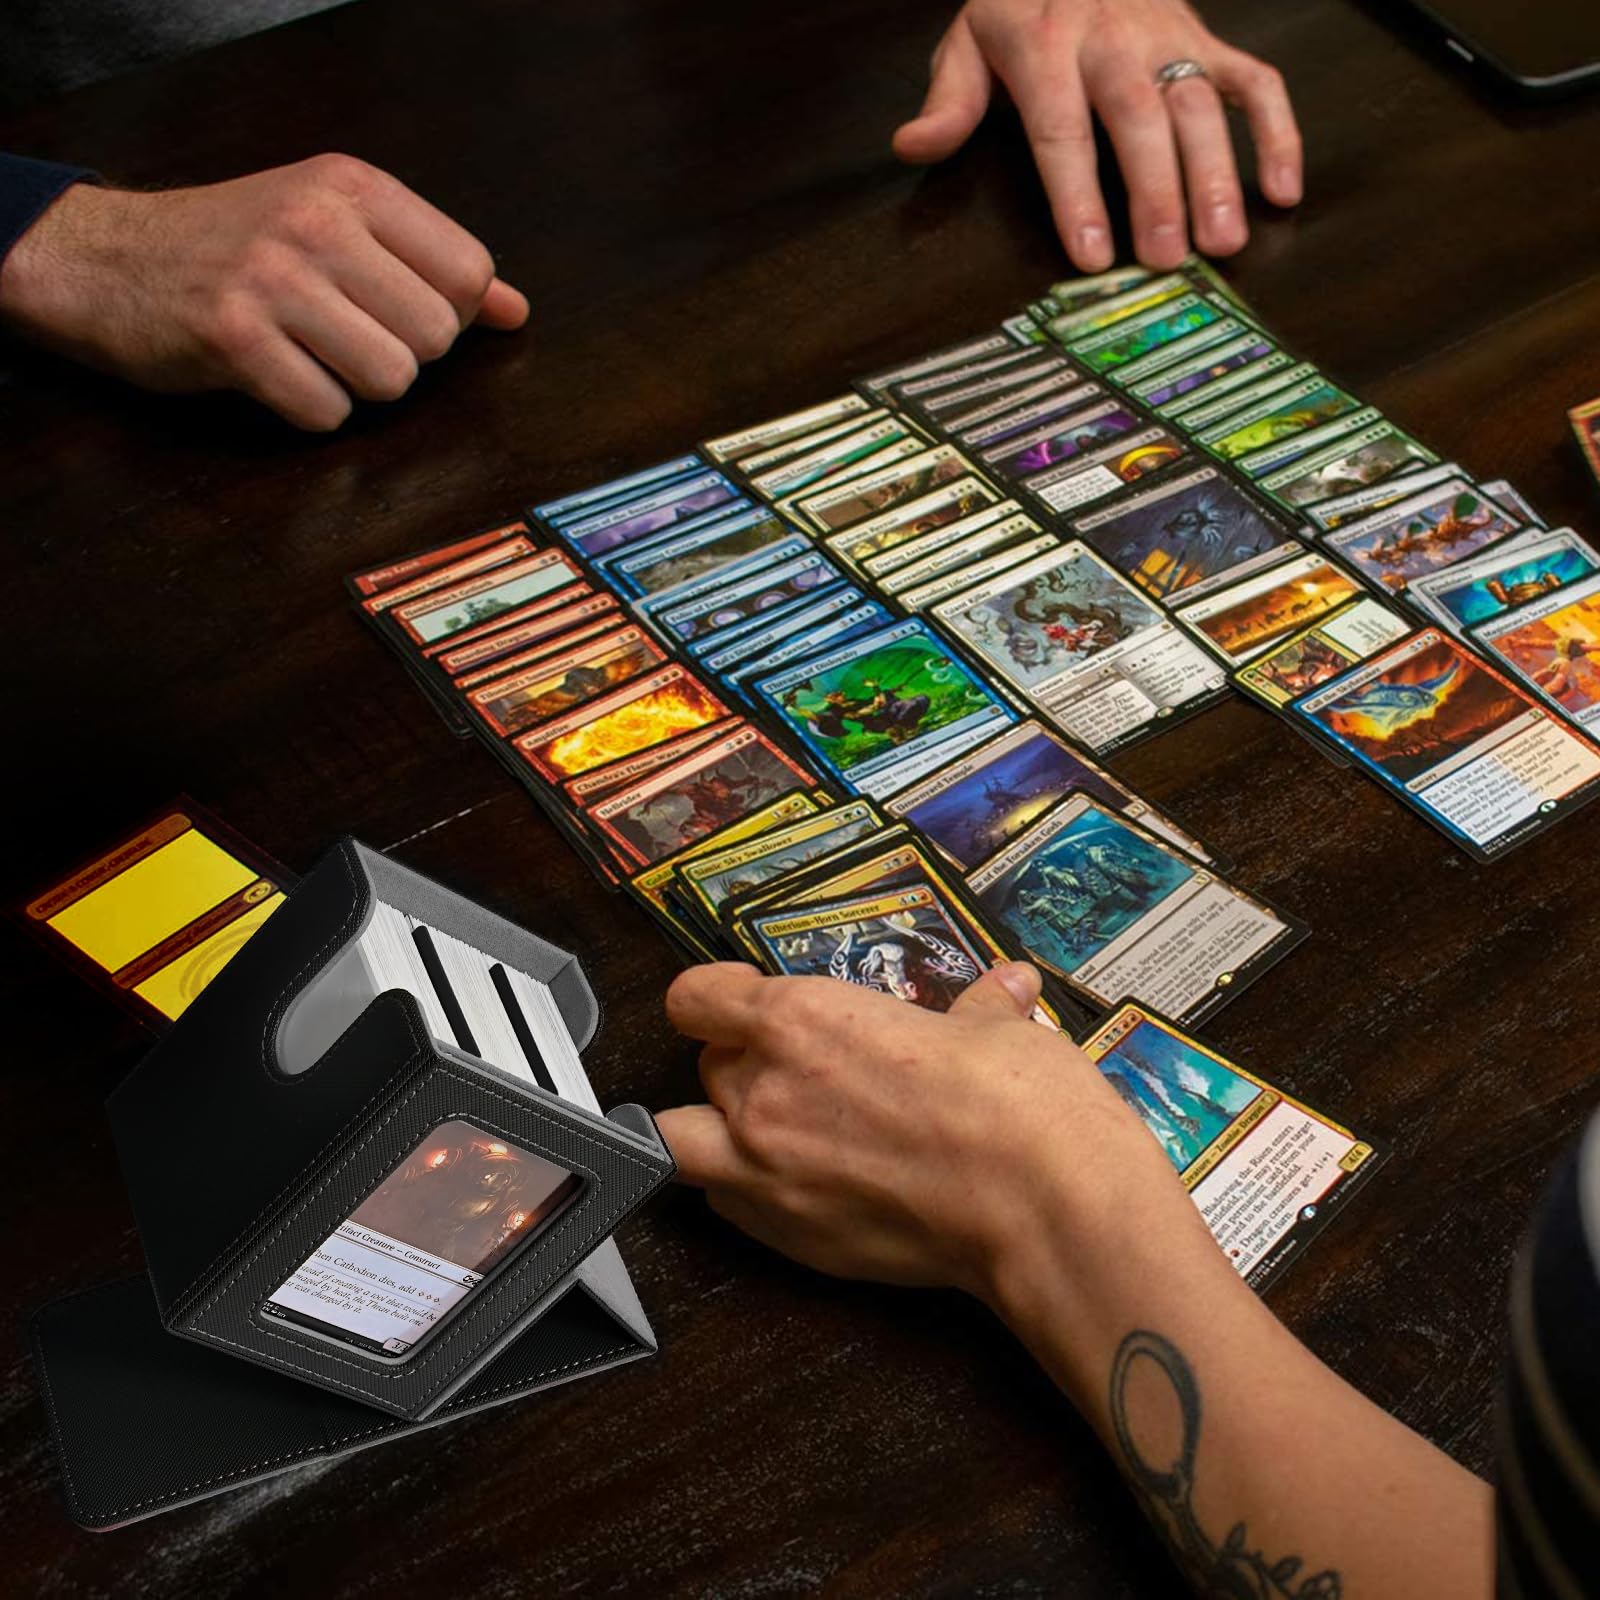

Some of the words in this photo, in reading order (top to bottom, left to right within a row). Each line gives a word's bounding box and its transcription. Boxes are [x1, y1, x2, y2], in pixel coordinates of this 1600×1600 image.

[897, 781, 943, 811] Drownyard
[944, 763, 973, 784] Temple
[695, 863, 722, 876] Simic
[723, 854, 743, 866] Sky
[744, 836, 793, 858] Swallower
[982, 871, 994, 882] of
[992, 861, 1008, 874] the
[1007, 835, 1042, 863] Forsaken
[1040, 820, 1062, 836] Gods
[767, 914, 839, 934] Etherium-Horn
[840, 904, 880, 917] Sorcerer
[1074, 965, 1096, 980] Land
[1184, 1159, 1210, 1185] Creature
[1216, 1129, 1240, 1152] Zombie
[1239, 1106, 1265, 1129] Dragon
[1344, 1148, 1363, 1164] 4/4
[1202, 1178, 1242, 1217] Bladewing
[1237, 1166, 1253, 1179] the
[1249, 1146, 1274, 1166] Risen
[1269, 1125, 1294, 1146] enters
[1207, 1192, 1242, 1227] attlefield,
[1240, 1180, 1257, 1194] you
[1254, 1164, 1273, 1181] may
[1268, 1142, 1293, 1164] return
[1289, 1121, 1314, 1142] target
[1228, 1184, 1268, 1224] permanent
[1262, 1166, 1283, 1184] card
[1279, 1149, 1301, 1168] from
[1297, 1134, 1318, 1151] your
[1243, 1211, 1255, 1223] to
[1251, 1198, 1267, 1213] the
[1264, 1163, 1302, 1201] battlefield.
[1239, 1216, 1269, 1248] Dragon
[1267, 1185, 1300, 1219] creatures
[1297, 1172, 1314, 1187] get
[1308, 1151, 1334, 1173] +1/+1
[338, 1225, 362, 1237] tifact
[361, 1234, 395, 1251] Creature
[403, 1251, 440, 1269] Construct
[1249, 1235, 1267, 1254] end
[1263, 1225, 1276, 1239] of
[1272, 1209, 1292, 1229] turn.
[300, 1265, 323, 1276] stead
[319, 1271, 334, 1282] of
[330, 1277, 363, 1293] creating
[369, 1291, 387, 1302] tool
[385, 1297, 404, 1309] that
[402, 1304, 428, 1317] would
[425, 1313, 437, 1322] be
[312, 1249, 334, 1261] hen
[332, 1257, 378, 1279] Cathodion
[376, 1275, 399, 1287] dies,
[397, 1282, 416, 1294] add
[294, 1283, 311, 1293] was
[310, 1289, 342, 1305] charged
[340, 1300, 355, 1311] by
[319, 1282, 333, 1292] by
[331, 1287, 354, 1299] heat,
[352, 1294, 367, 1304] the
[365, 1300, 391, 1313] Thran
[389, 1309, 411, 1320] built
[407, 1317, 424, 1327] one
